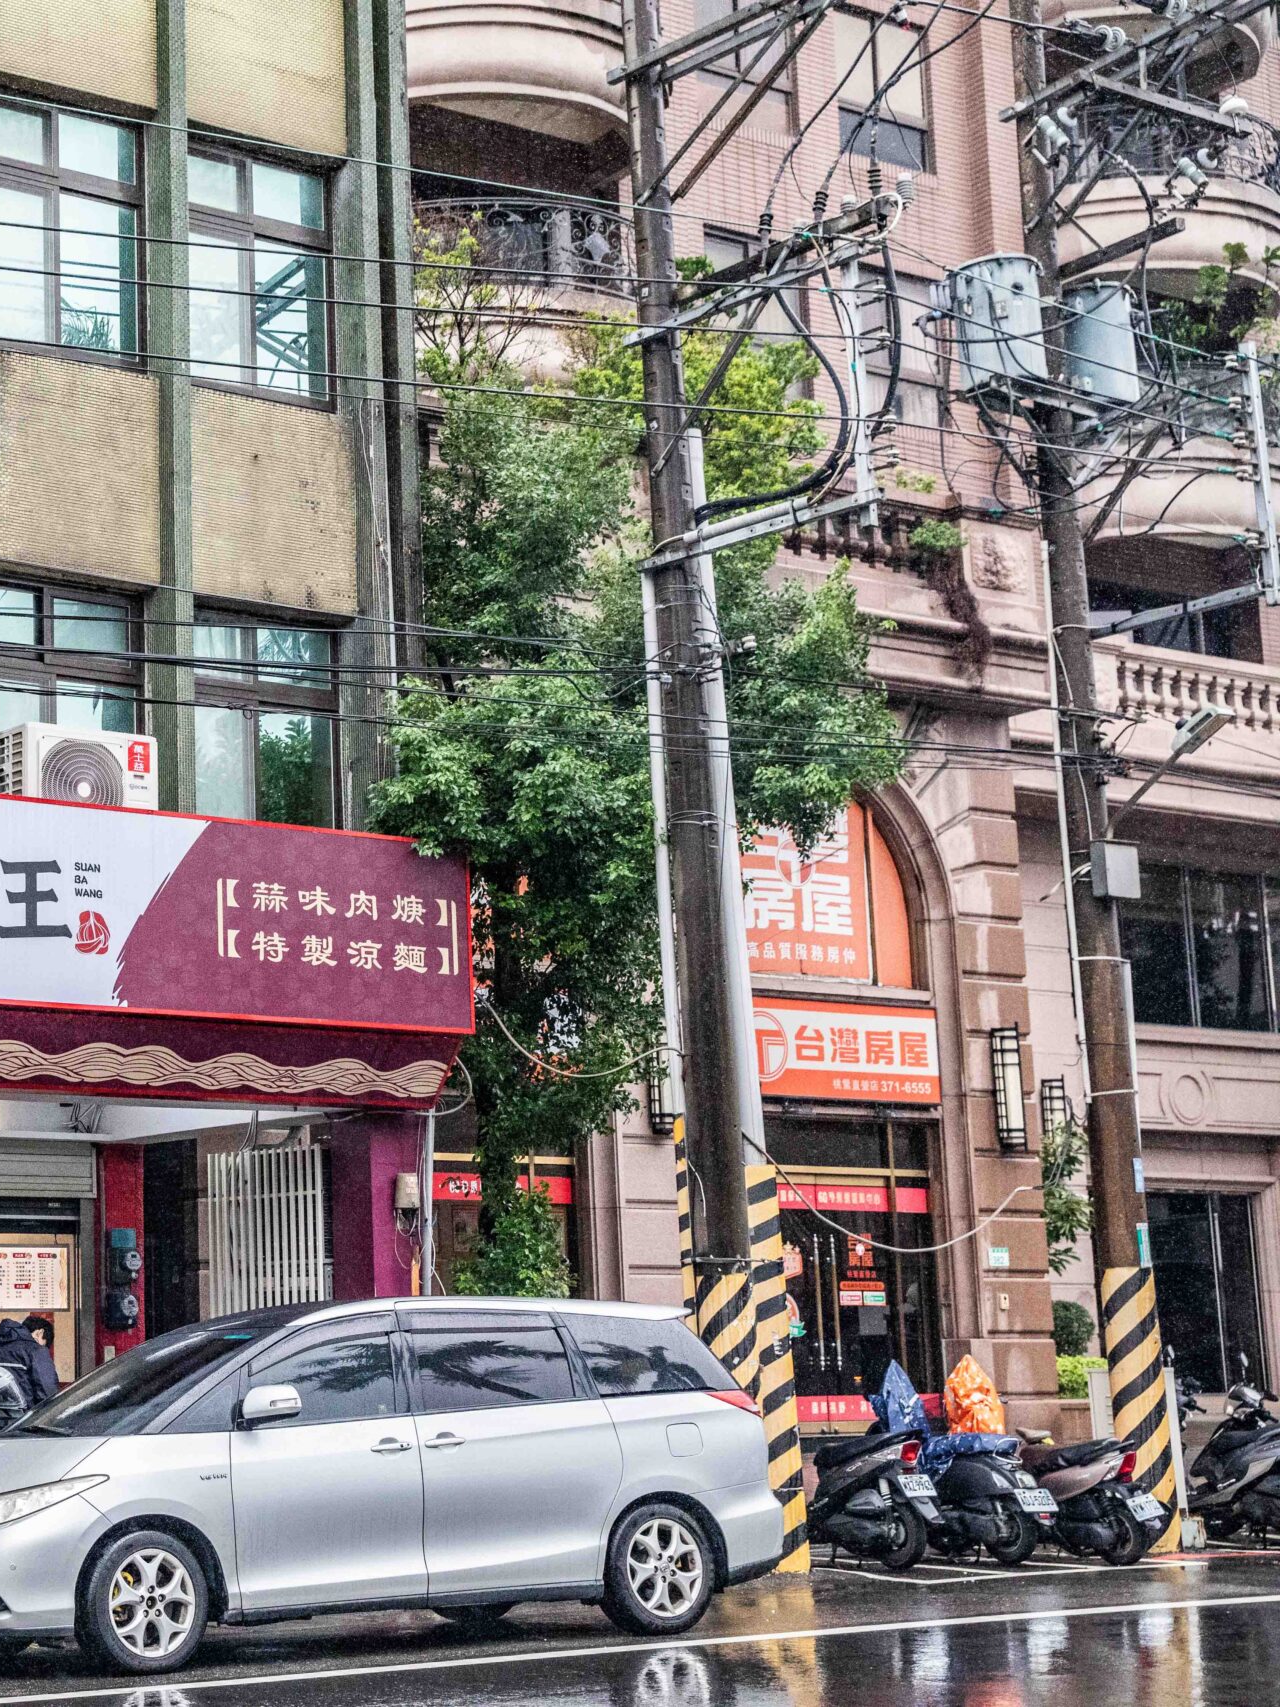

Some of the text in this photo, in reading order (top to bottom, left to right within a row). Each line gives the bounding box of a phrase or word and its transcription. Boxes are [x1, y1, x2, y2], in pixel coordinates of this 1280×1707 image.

[74, 862, 101, 873] SUAN
[74, 875, 88, 885] BA
[74, 887, 103, 899] WANG
[794, 1024, 929, 1068] 台灣房屋
[881, 1080, 932, 1095] 371-6555
